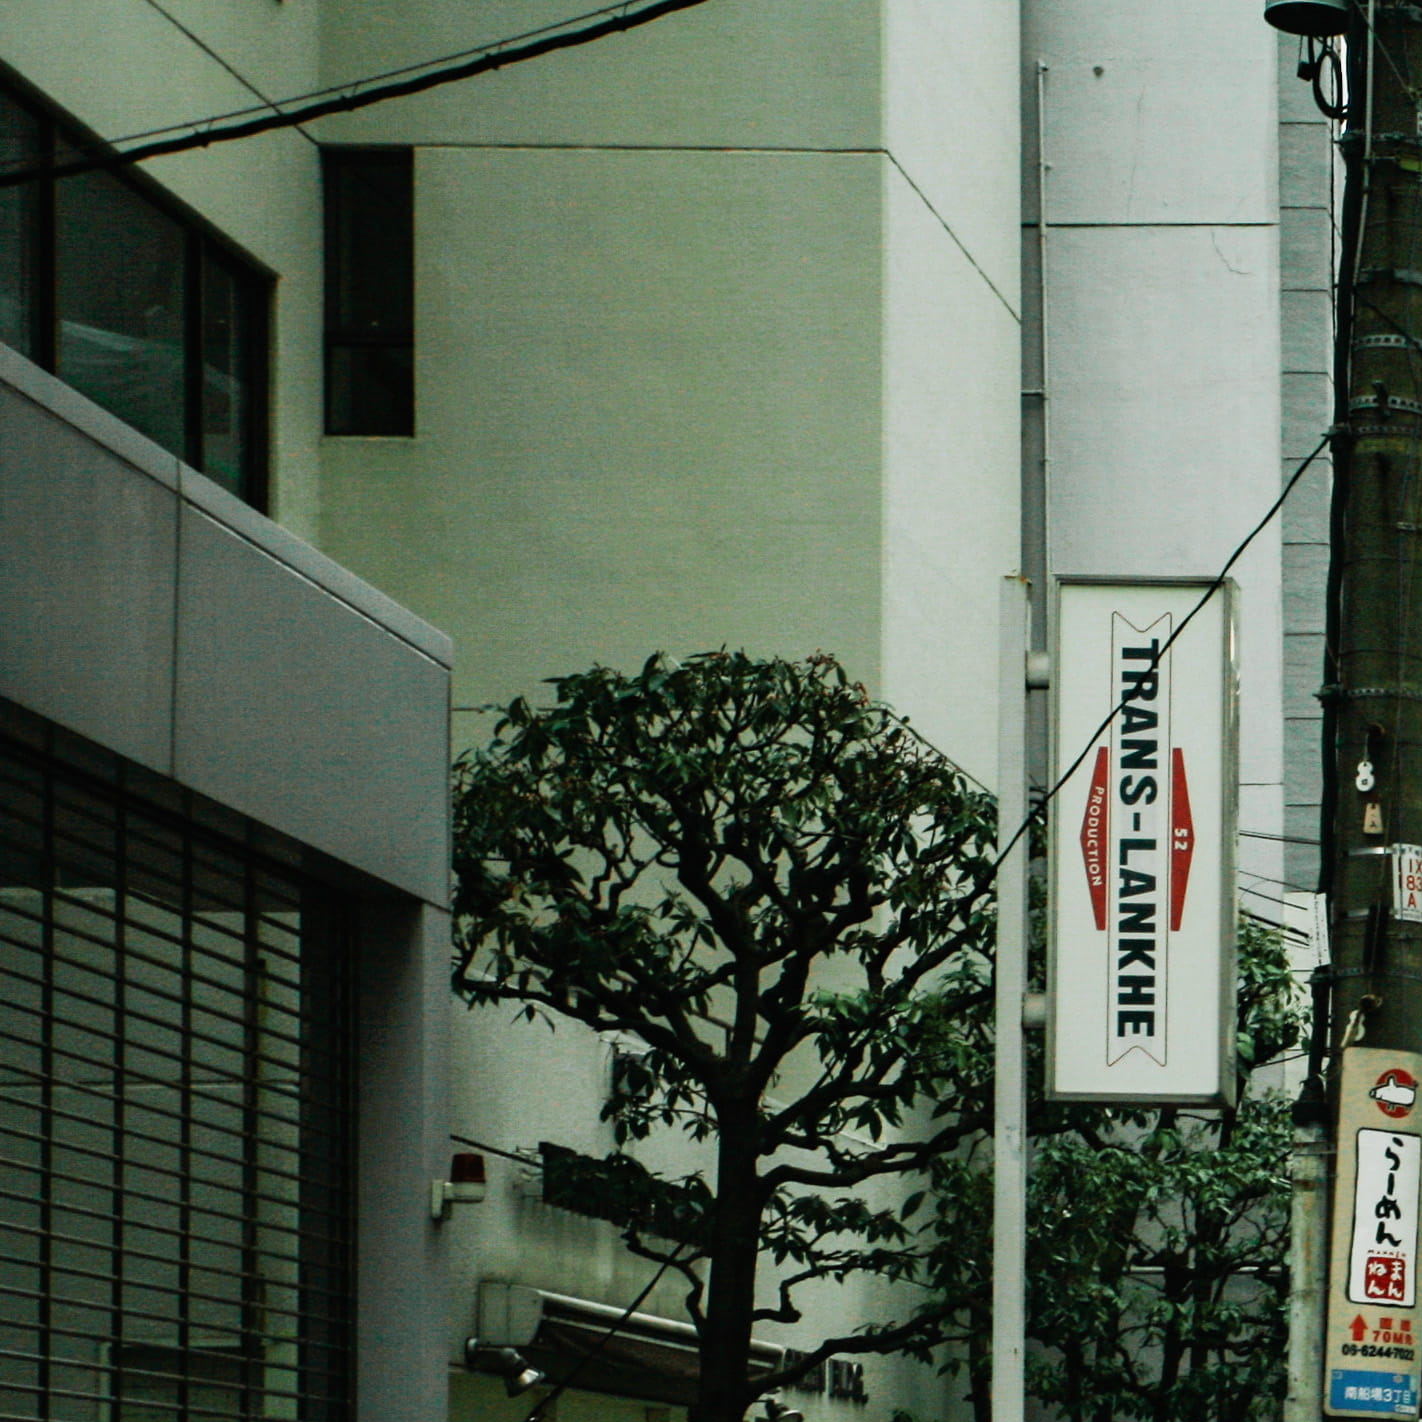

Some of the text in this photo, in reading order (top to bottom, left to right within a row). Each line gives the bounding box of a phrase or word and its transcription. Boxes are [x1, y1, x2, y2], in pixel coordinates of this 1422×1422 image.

[1082, 785, 1105, 888] PRODUCTION
[1116, 638, 1159, 1038] TRANS-LANKHE
[1408, 893, 1416, 908] A
[1374, 1135, 1405, 1248] らーめん
